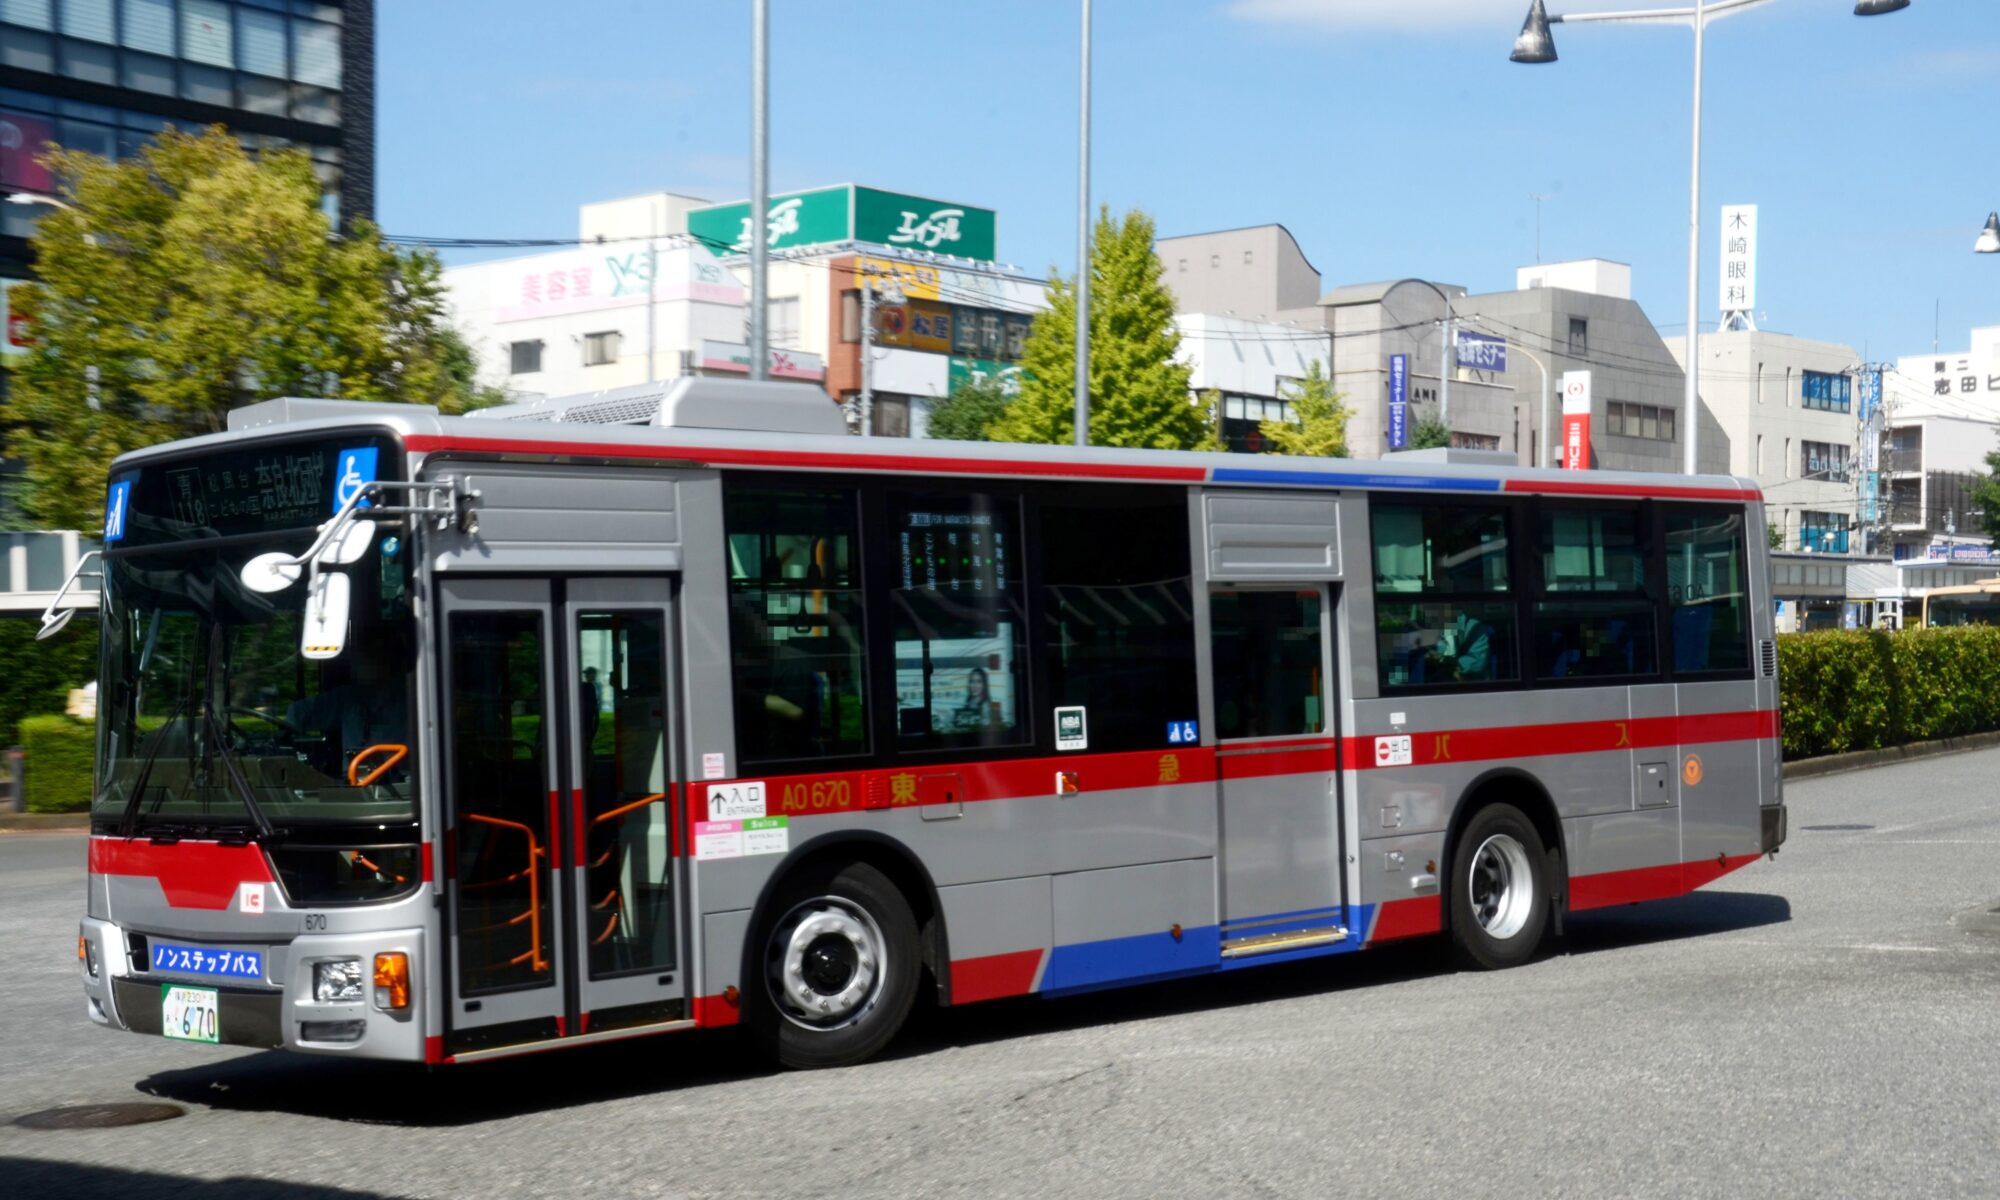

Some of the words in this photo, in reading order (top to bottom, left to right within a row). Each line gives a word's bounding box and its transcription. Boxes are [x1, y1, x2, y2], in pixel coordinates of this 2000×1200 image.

[1727, 211, 1748, 304] 木崎眼科
[912, 310, 949, 339] 松屋
[889, 772, 917, 804] 東
[1158, 753, 1180, 782] 急
[1432, 734, 1451, 761] バ
[1615, 722, 1631, 747] ス
[730, 786, 760, 804] 入口
[781, 783, 808, 810] AO
[811, 780, 850, 808] 670
[727, 804, 764, 816] ENTRANCE
[750, 818, 778, 829] Suica
[305, 913, 327, 931] 670
[155, 948, 259, 976] ノンステップバス
